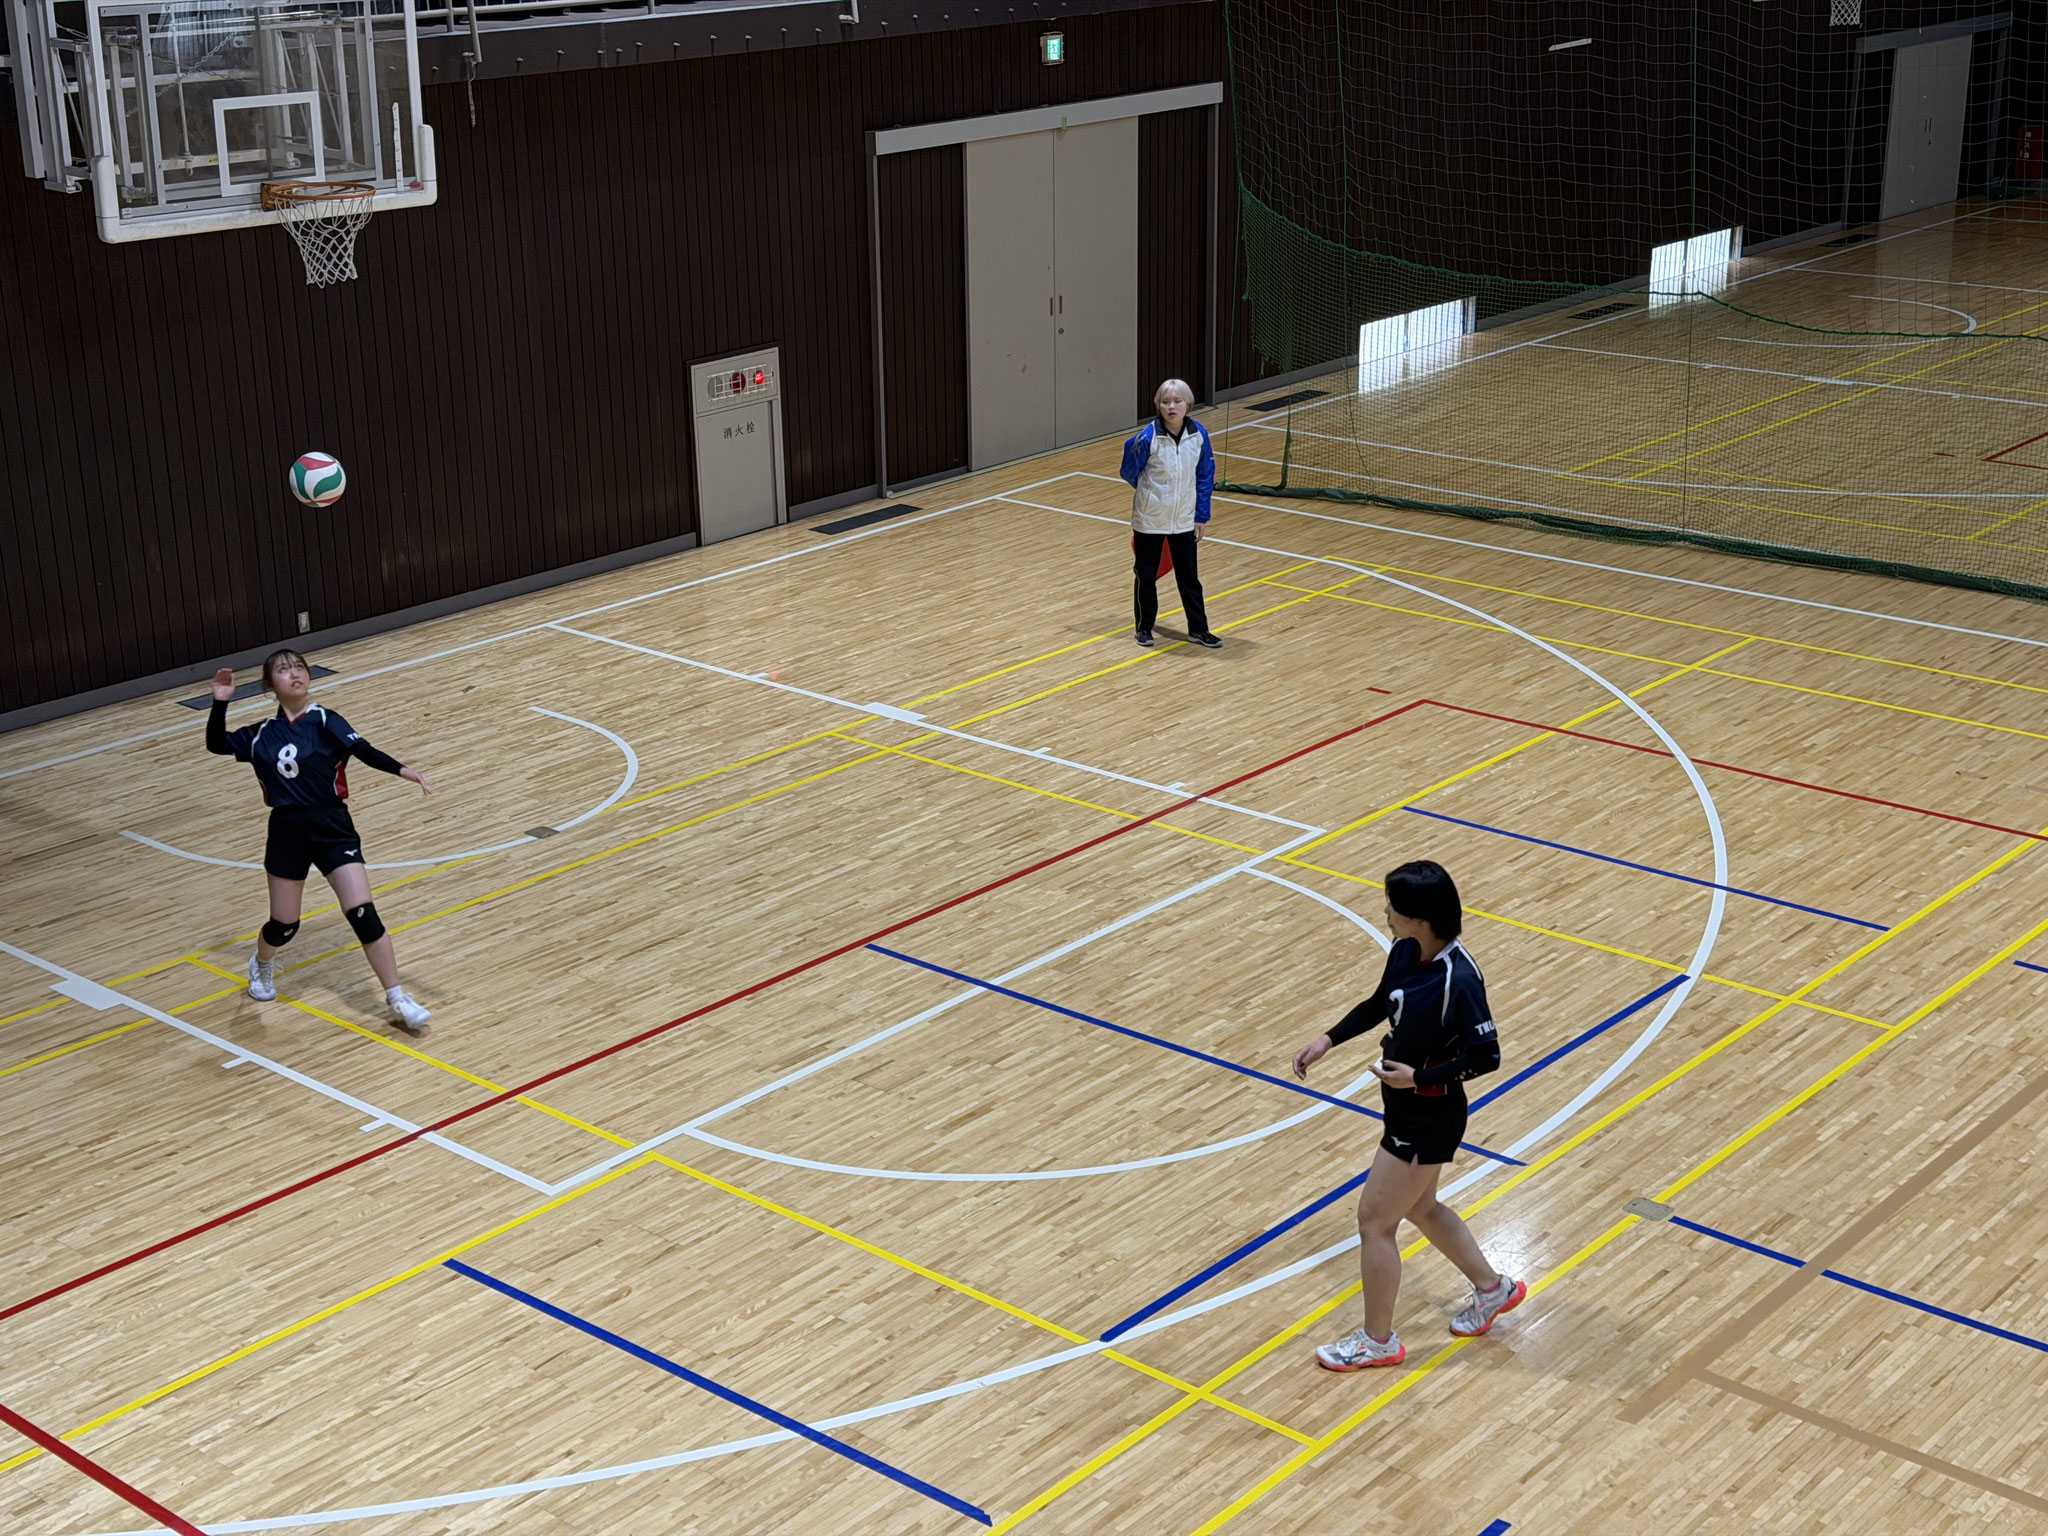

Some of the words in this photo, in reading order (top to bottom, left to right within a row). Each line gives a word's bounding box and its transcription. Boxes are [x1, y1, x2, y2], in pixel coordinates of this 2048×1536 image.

[723, 421, 756, 440] 消火栓
[277, 743, 299, 779] 8
